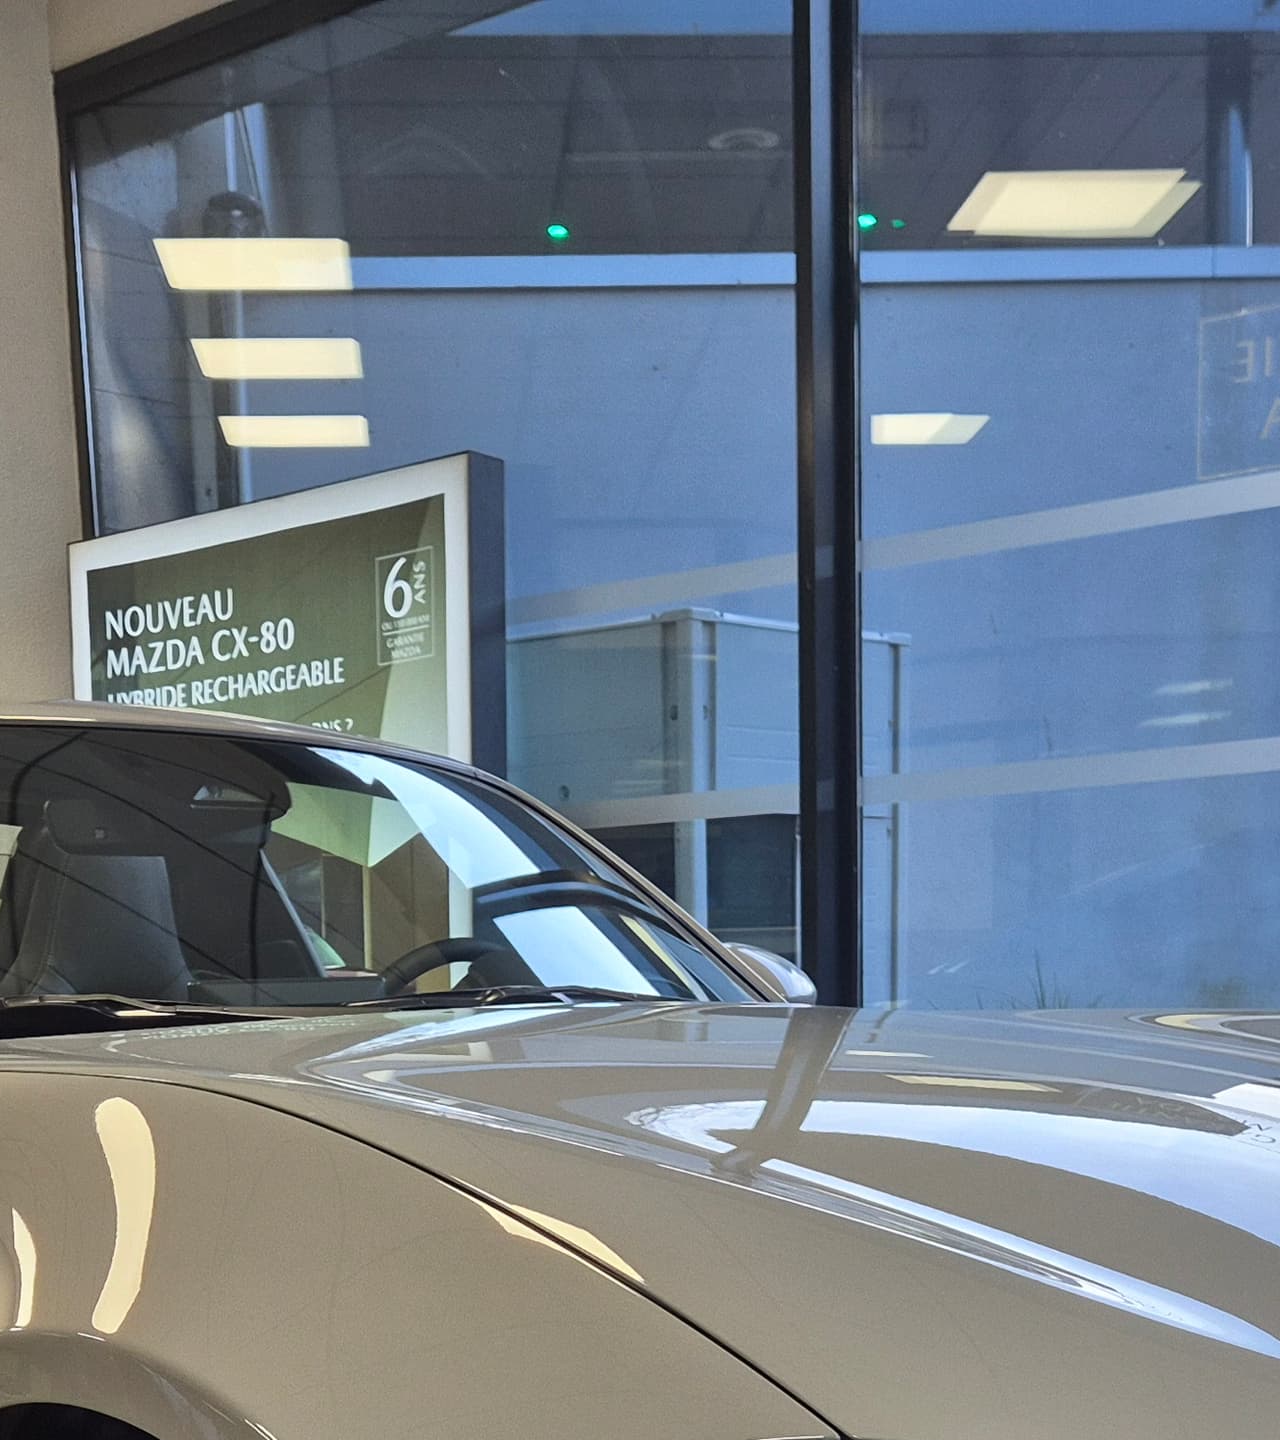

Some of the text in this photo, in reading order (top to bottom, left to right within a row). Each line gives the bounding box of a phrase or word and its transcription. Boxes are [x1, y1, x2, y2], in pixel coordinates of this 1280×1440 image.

[104, 587, 234, 641] NOUVEAU
[383, 556, 427, 619] 6 ANS
[106, 616, 296, 680] MAZDA CX-80
[191, 656, 345, 707] RECHARGEABLE
